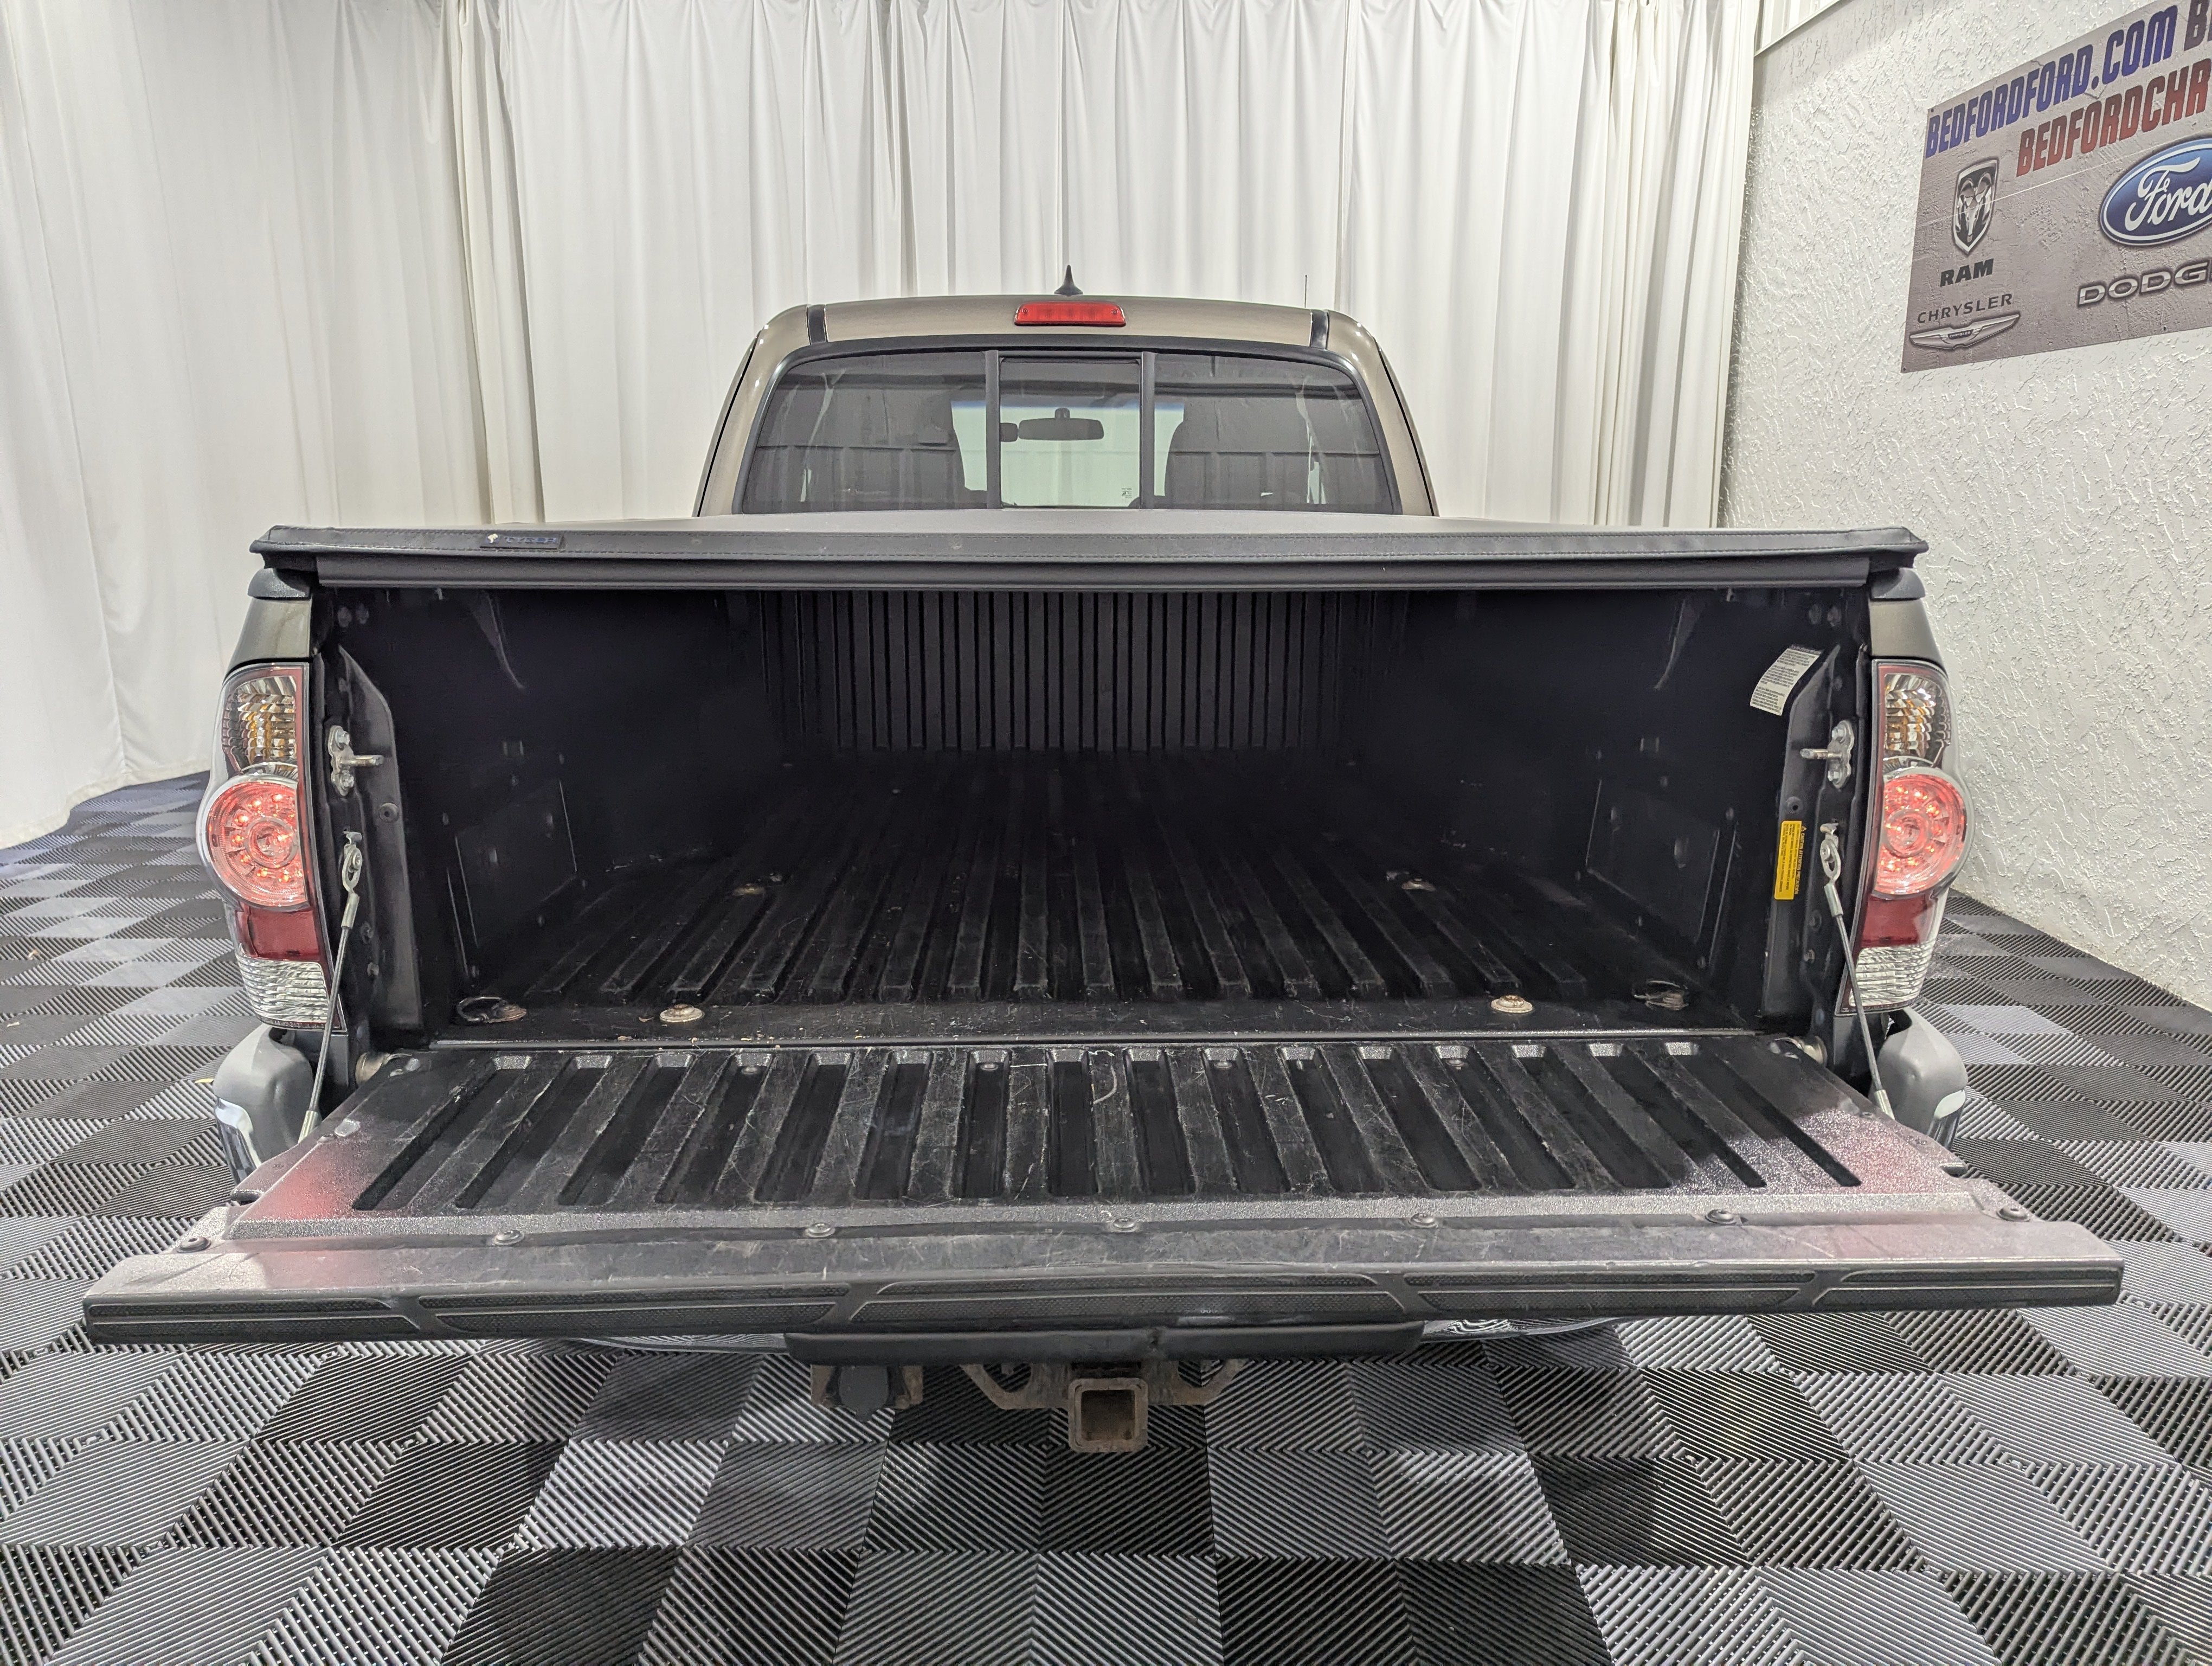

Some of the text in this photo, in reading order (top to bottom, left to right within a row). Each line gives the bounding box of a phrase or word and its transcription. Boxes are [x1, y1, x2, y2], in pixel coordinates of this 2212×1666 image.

[1925, 5, 2178, 159] BEDFORDFORD.COM
[2016, 58, 2212, 177] BEDFORDCHR
[1940, 258, 1994, 286] RAM
[2079, 261, 2212, 305] DODG
[1918, 293, 2012, 323] CHRYSLER
